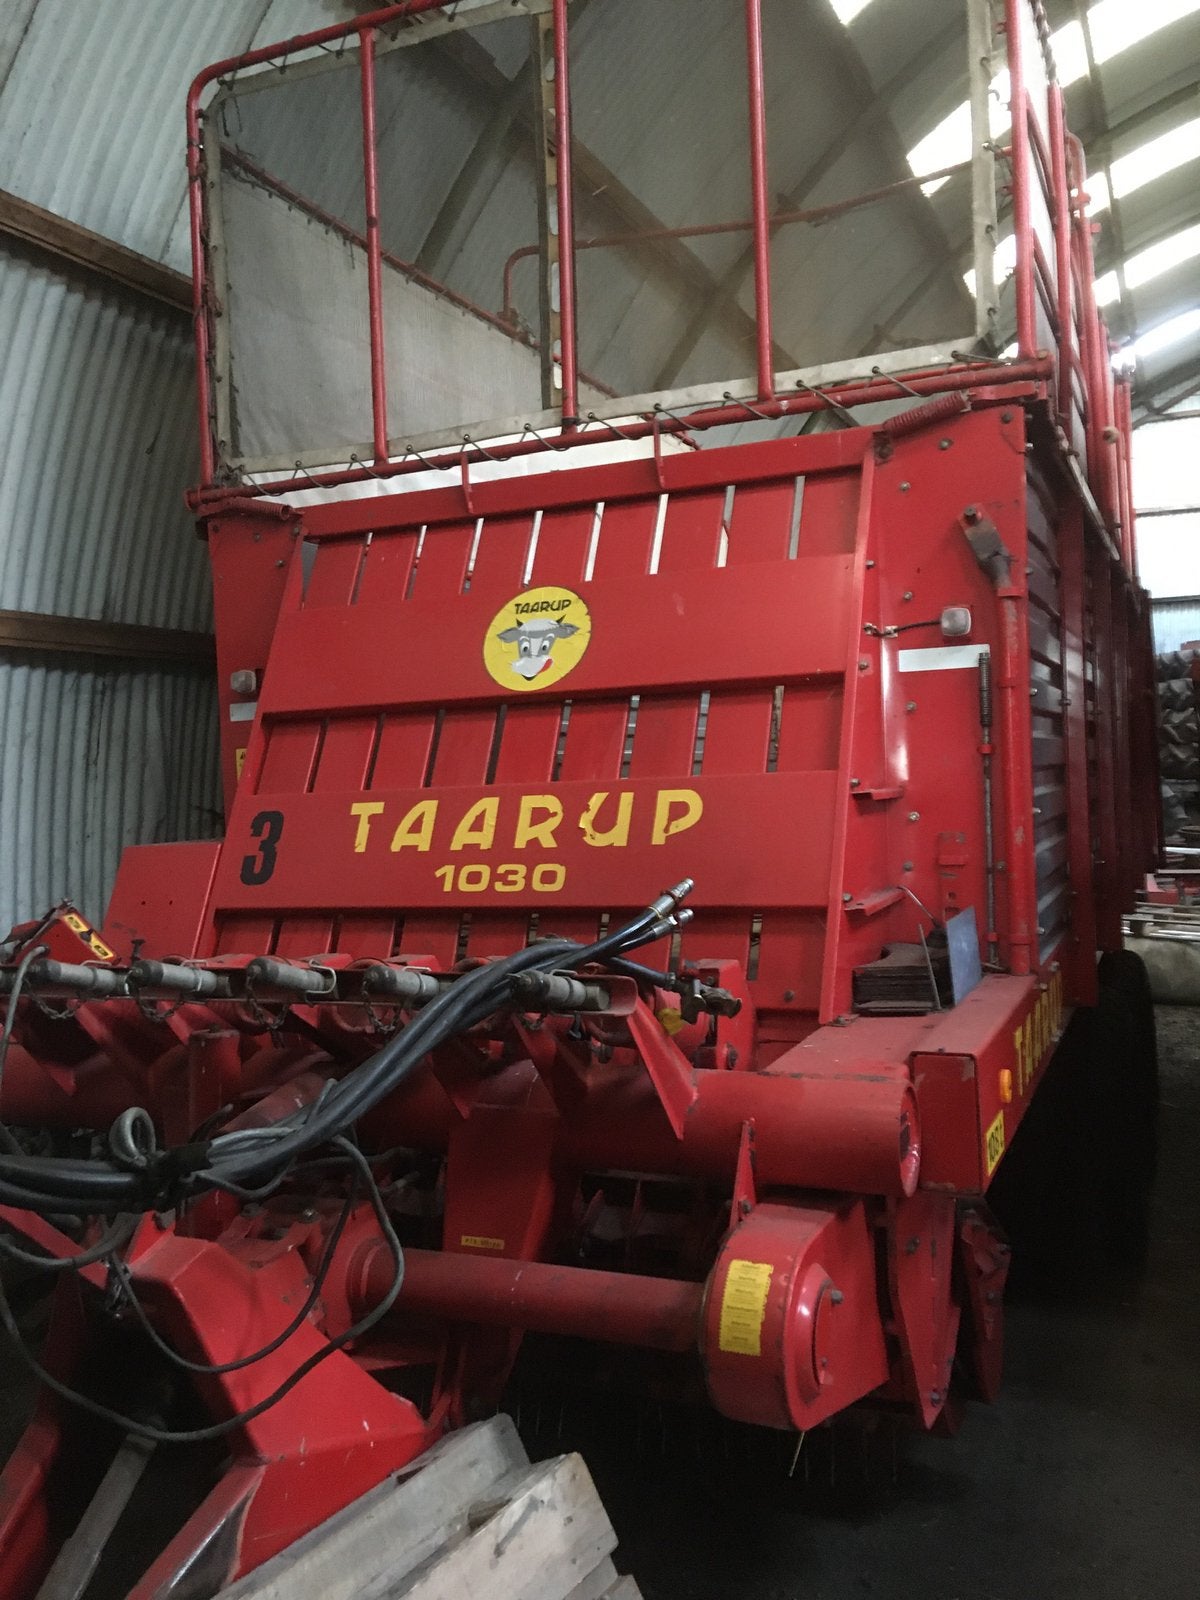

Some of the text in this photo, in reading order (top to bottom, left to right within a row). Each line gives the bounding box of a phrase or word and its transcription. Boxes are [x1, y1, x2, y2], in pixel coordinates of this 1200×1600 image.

[514, 599, 572, 615] TAARUP
[350, 788, 704, 854] TAARUP
[239, 810, 285, 887] 3
[434, 863, 567, 893] 1030
